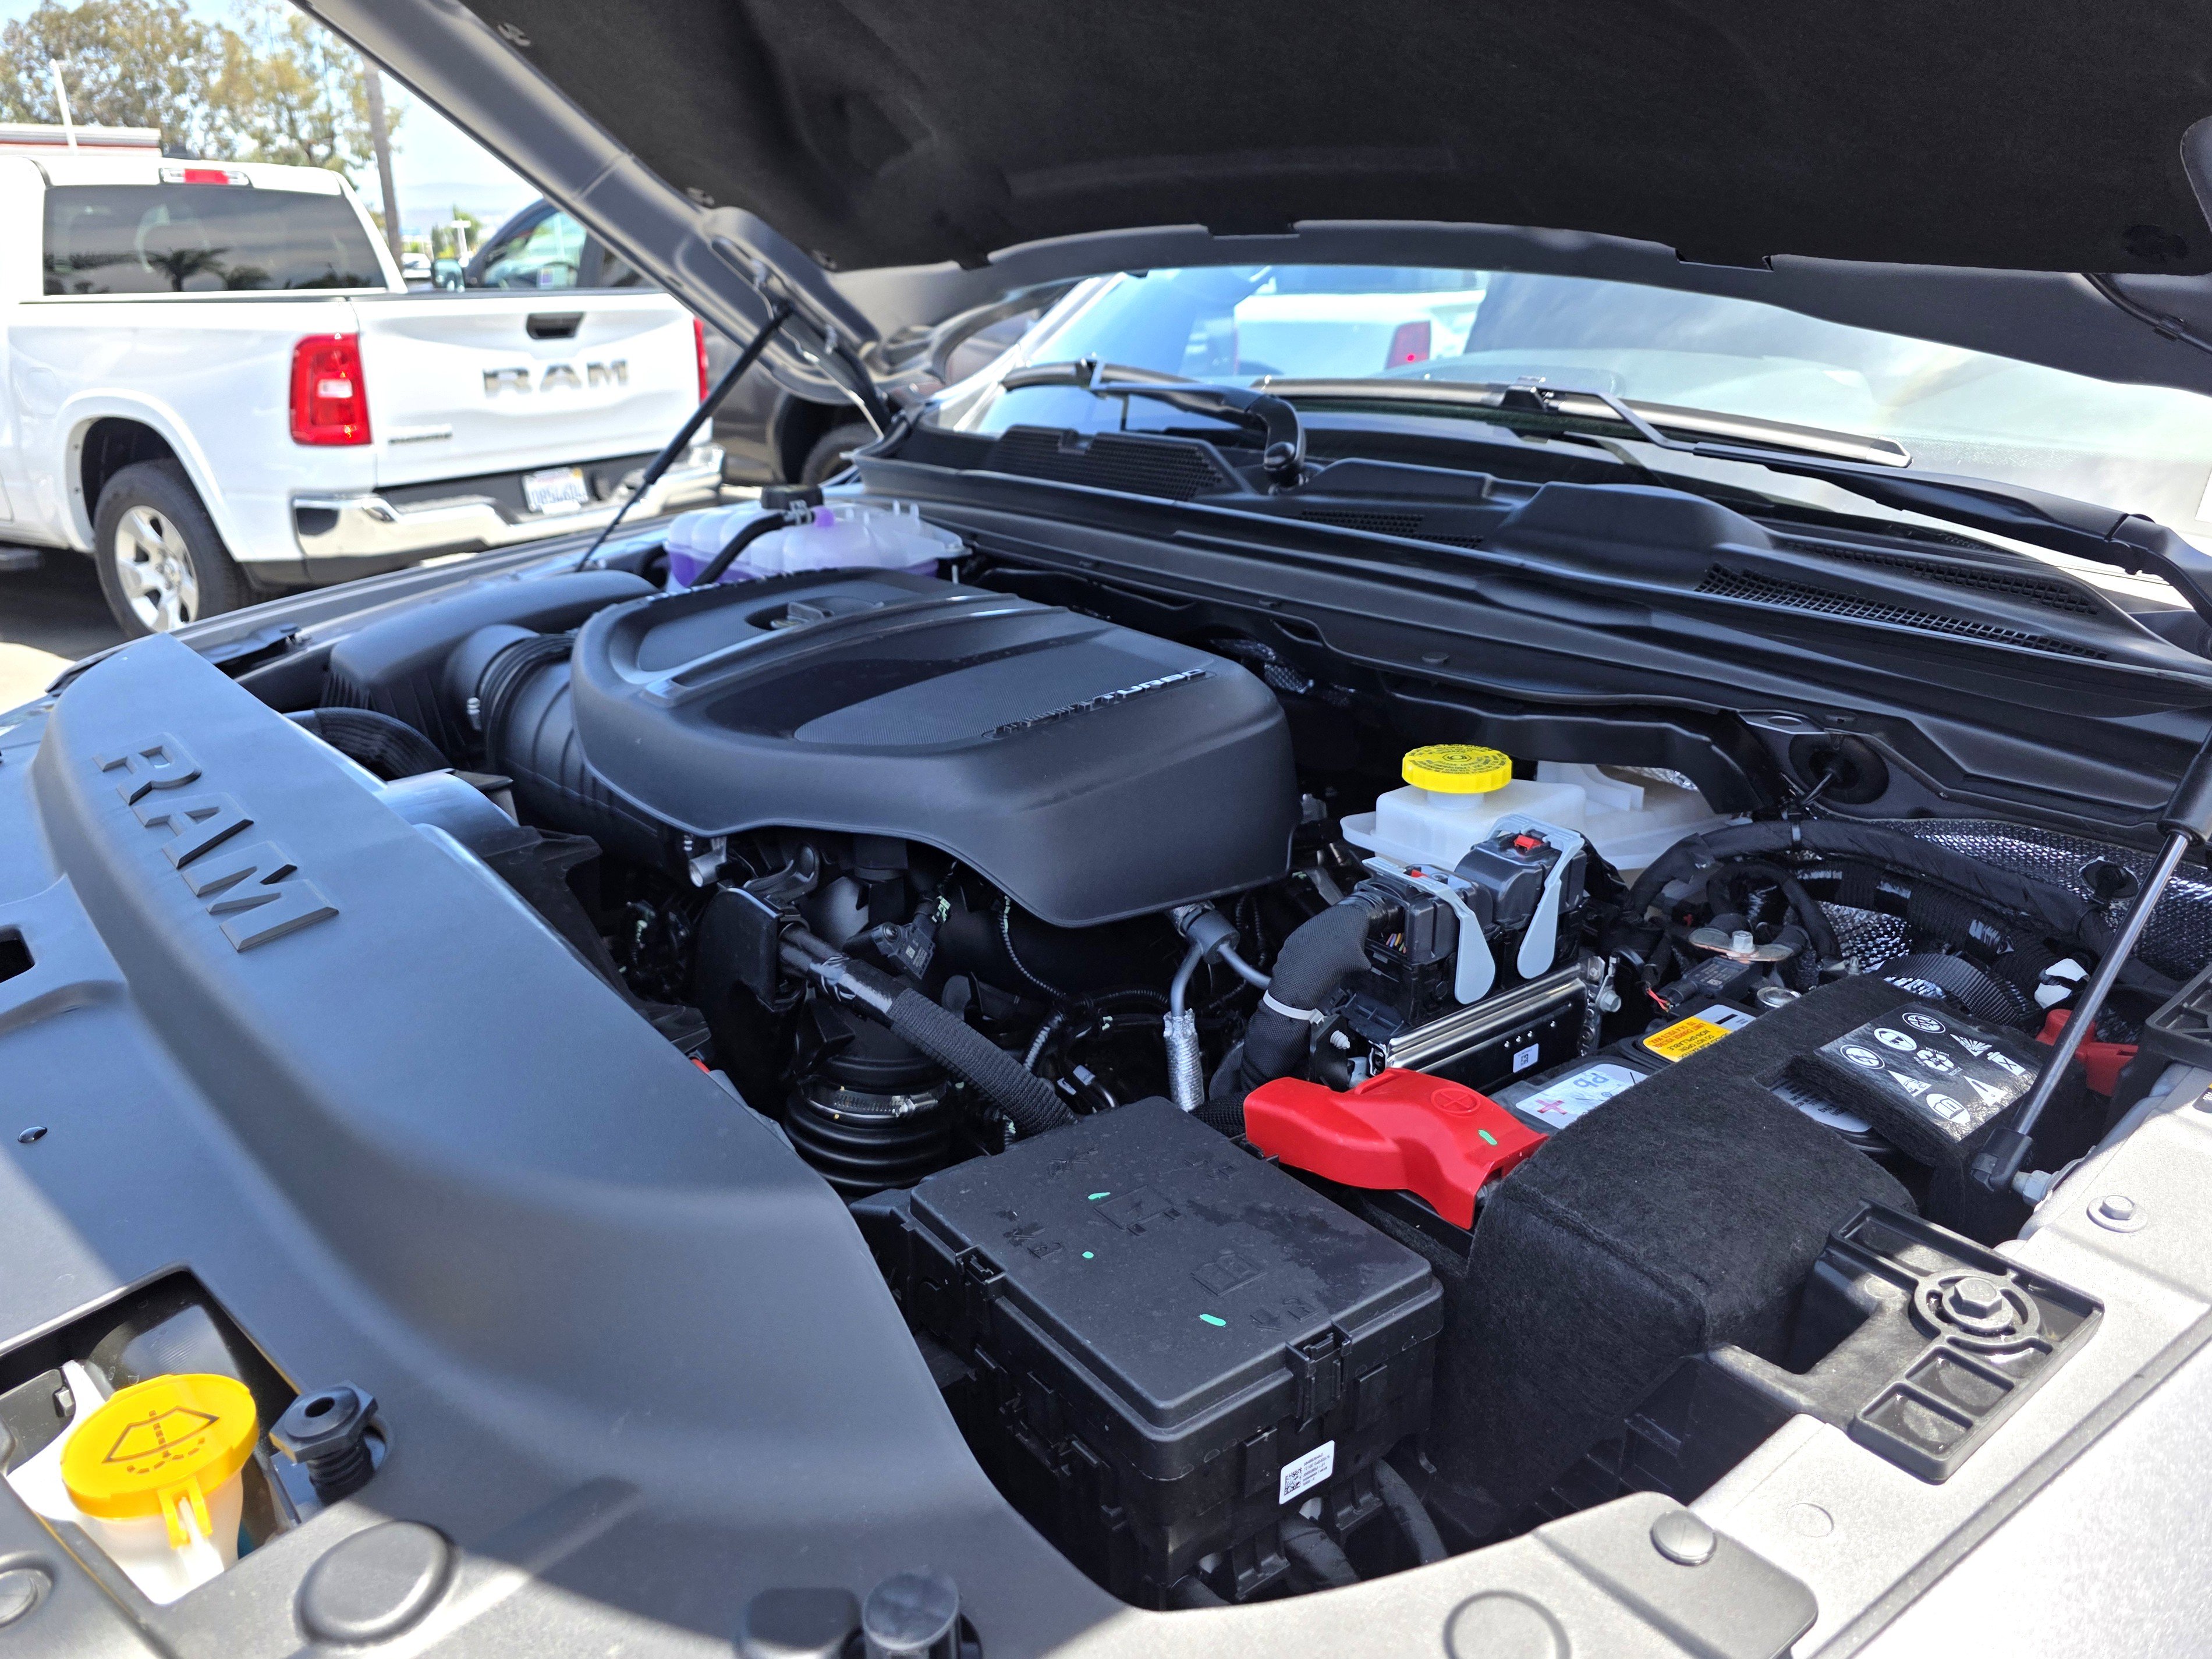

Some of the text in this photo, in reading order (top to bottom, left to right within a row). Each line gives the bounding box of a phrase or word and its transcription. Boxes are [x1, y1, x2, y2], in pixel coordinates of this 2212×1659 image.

[483, 358, 629, 398] RAM
[1092, 668, 1206, 703] TURBO
[91, 732, 340, 952] RAM
[1926, 1047, 1949, 1057] RETURN
[1573, 1072, 1610, 1088] Pb
